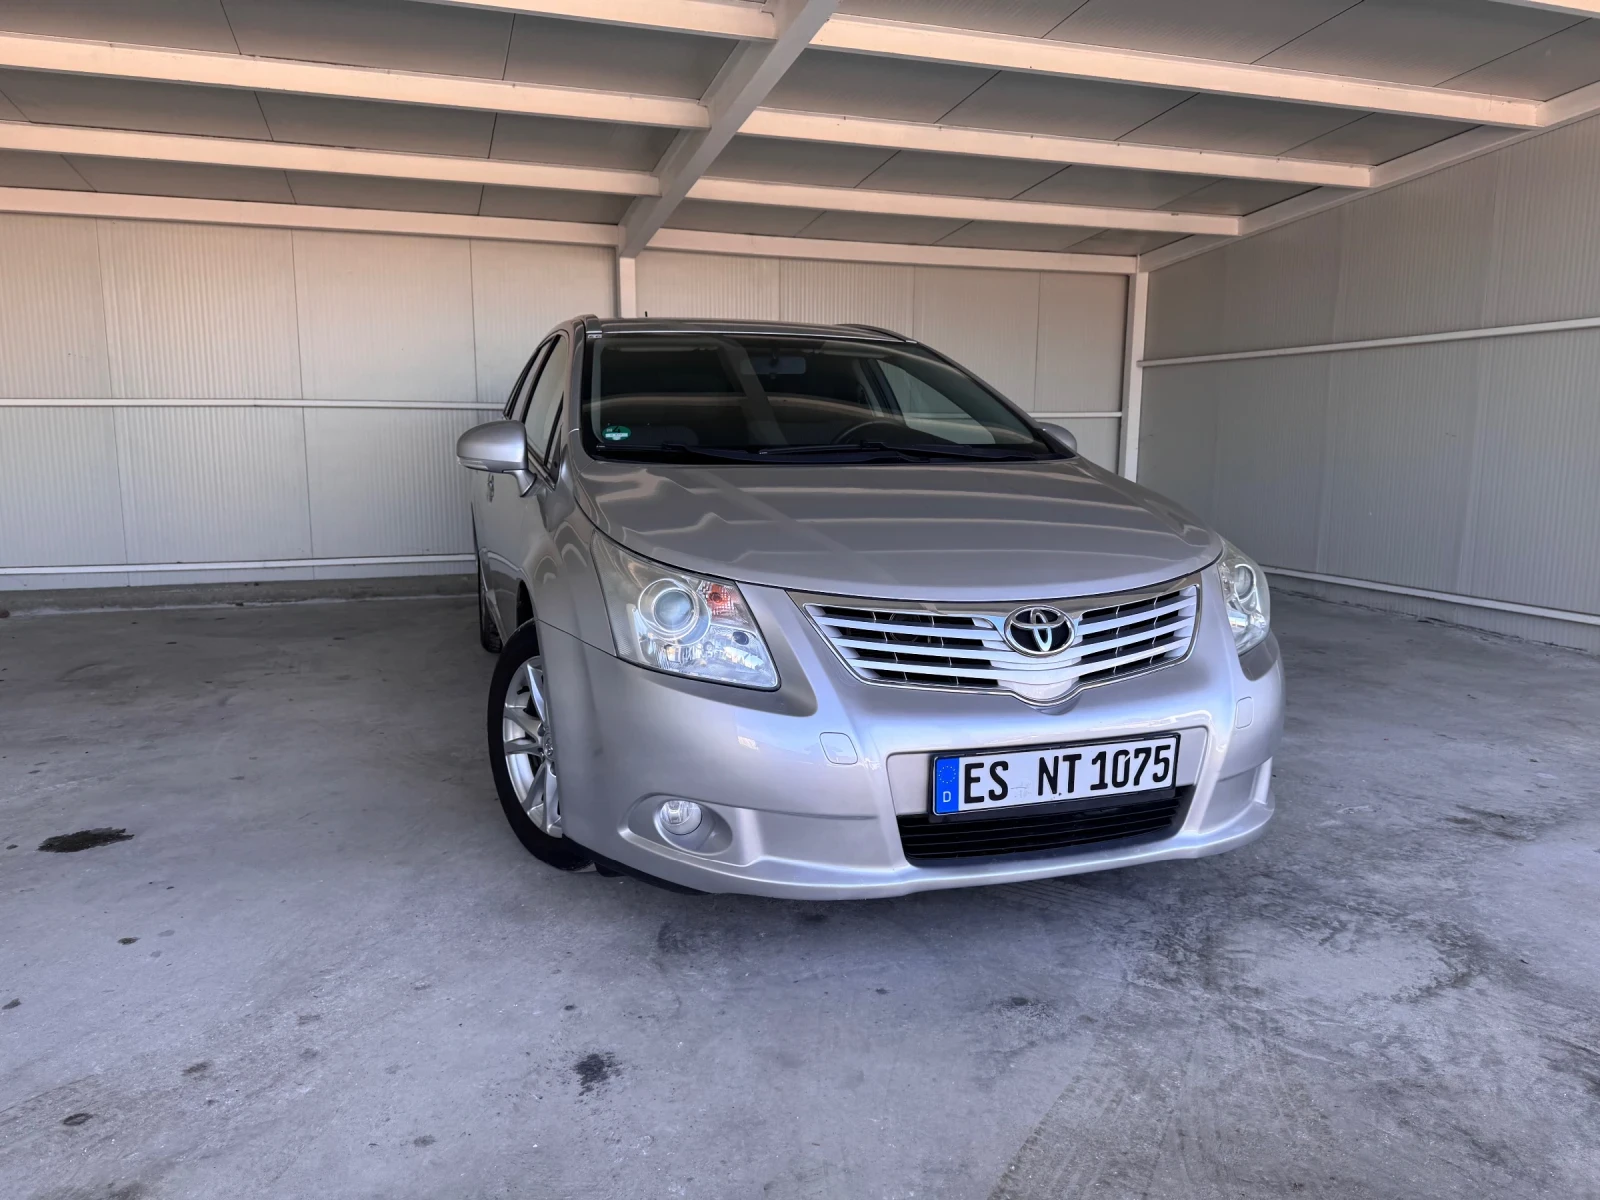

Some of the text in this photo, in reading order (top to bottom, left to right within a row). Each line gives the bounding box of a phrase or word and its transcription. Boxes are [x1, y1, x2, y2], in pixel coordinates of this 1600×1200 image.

[964, 745, 1171, 804] ES NT 1075
[942, 790, 952, 803] D
